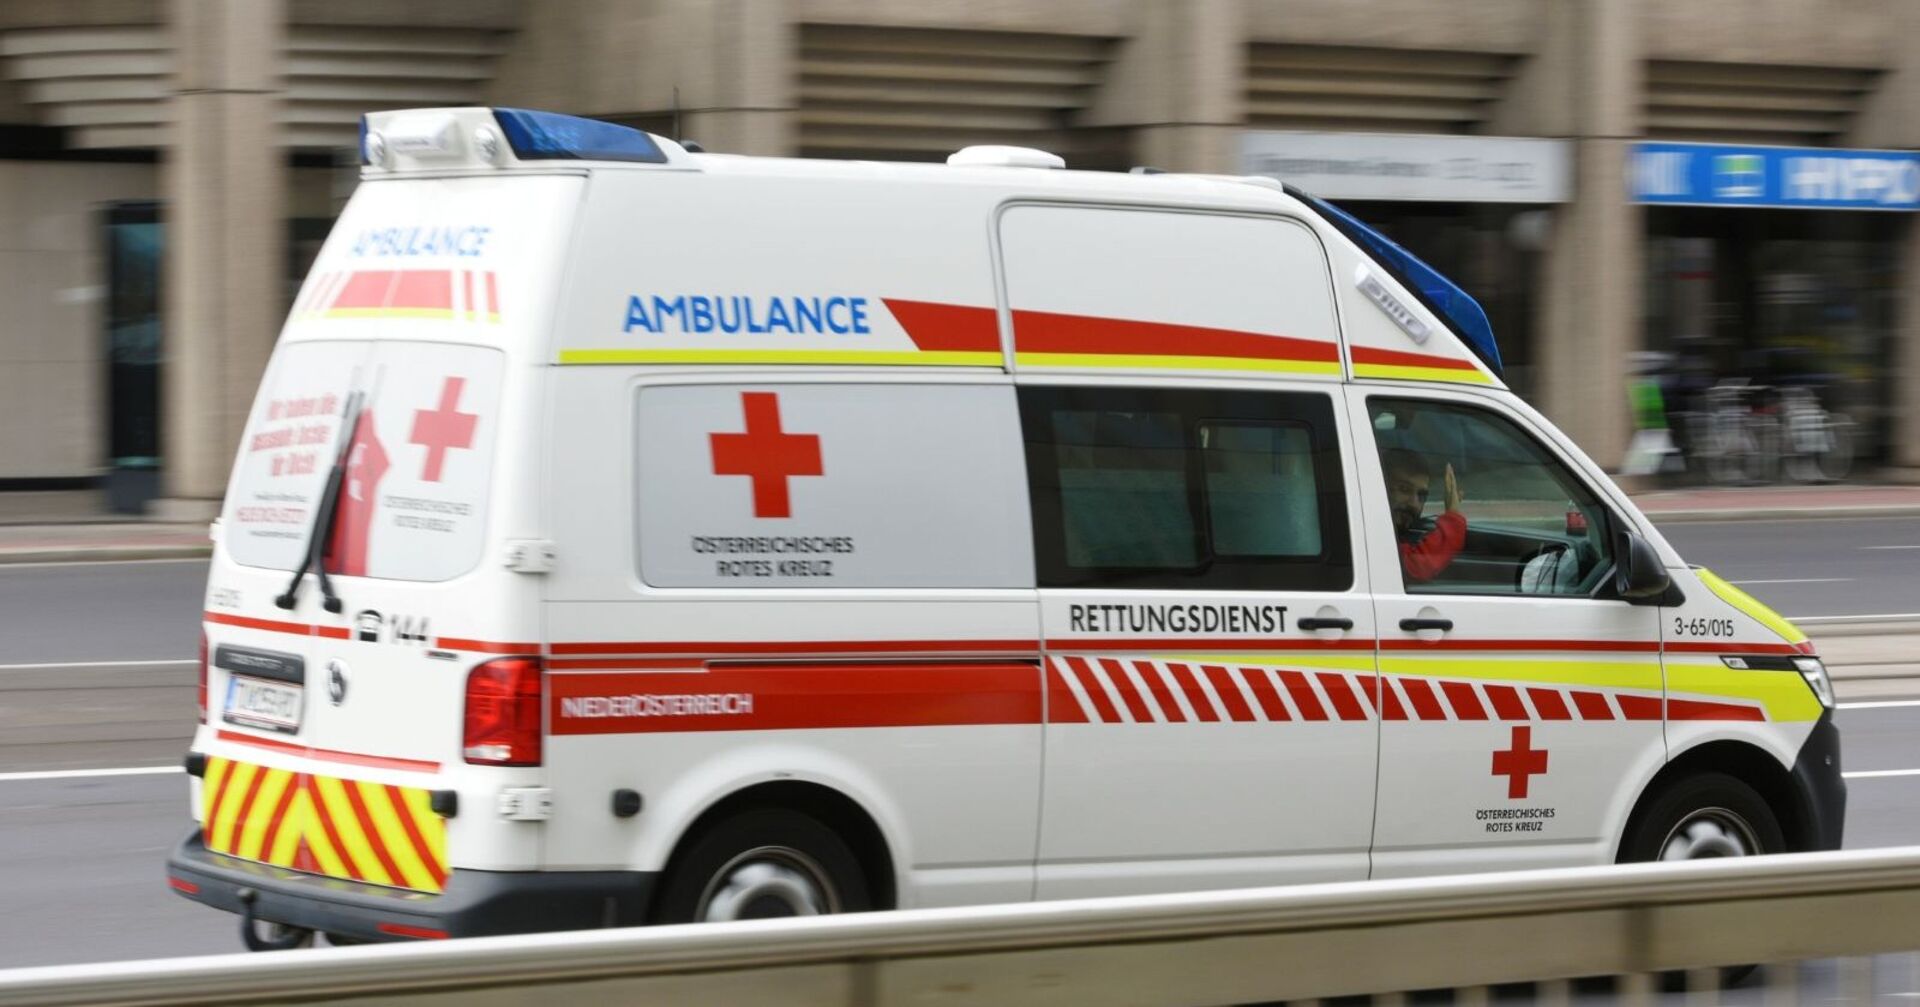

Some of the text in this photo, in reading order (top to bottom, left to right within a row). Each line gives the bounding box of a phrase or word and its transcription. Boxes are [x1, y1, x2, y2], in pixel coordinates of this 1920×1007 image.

[348, 225, 491, 257] AMBULANCE
[623, 295, 871, 334] AMBULANCE
[691, 535, 855, 553] ÖSTERREICHISCHES
[716, 560, 834, 577] ROTES KREUZ
[390, 613, 431, 646] 144
[1070, 604, 1288, 633] RETTUNGSDIENST
[1674, 617, 1734, 637] 3-65/015
[561, 692, 754, 718] NIEDERÖSTERREICH
[1475, 808, 1555, 820] ÖSTERREICHISCHES
[1486, 821, 1543, 833] ROTES KREUZ
